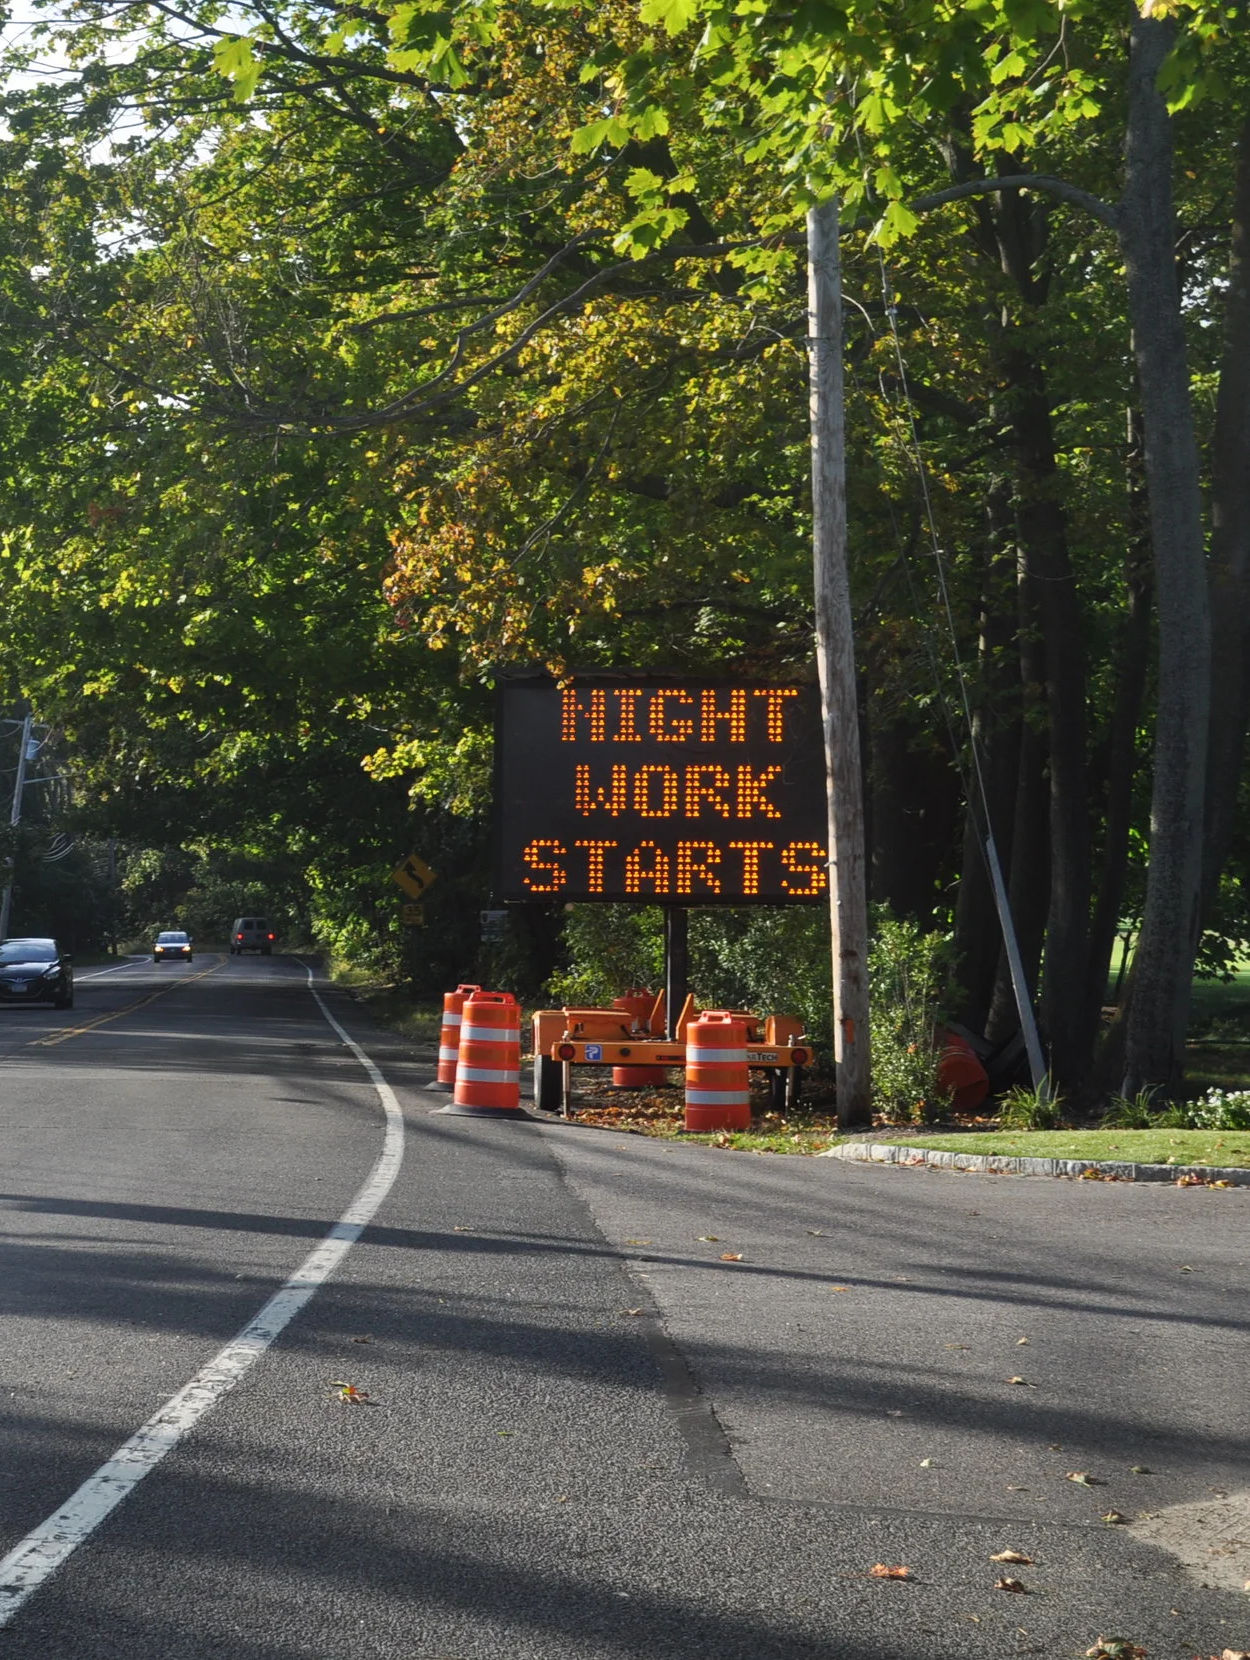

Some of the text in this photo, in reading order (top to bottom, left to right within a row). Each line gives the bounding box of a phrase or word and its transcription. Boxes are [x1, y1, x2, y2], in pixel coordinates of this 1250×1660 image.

[561, 689, 798, 742] NIGHT
[576, 765, 781, 818] WORK
[524, 840, 826, 894] STARTS
